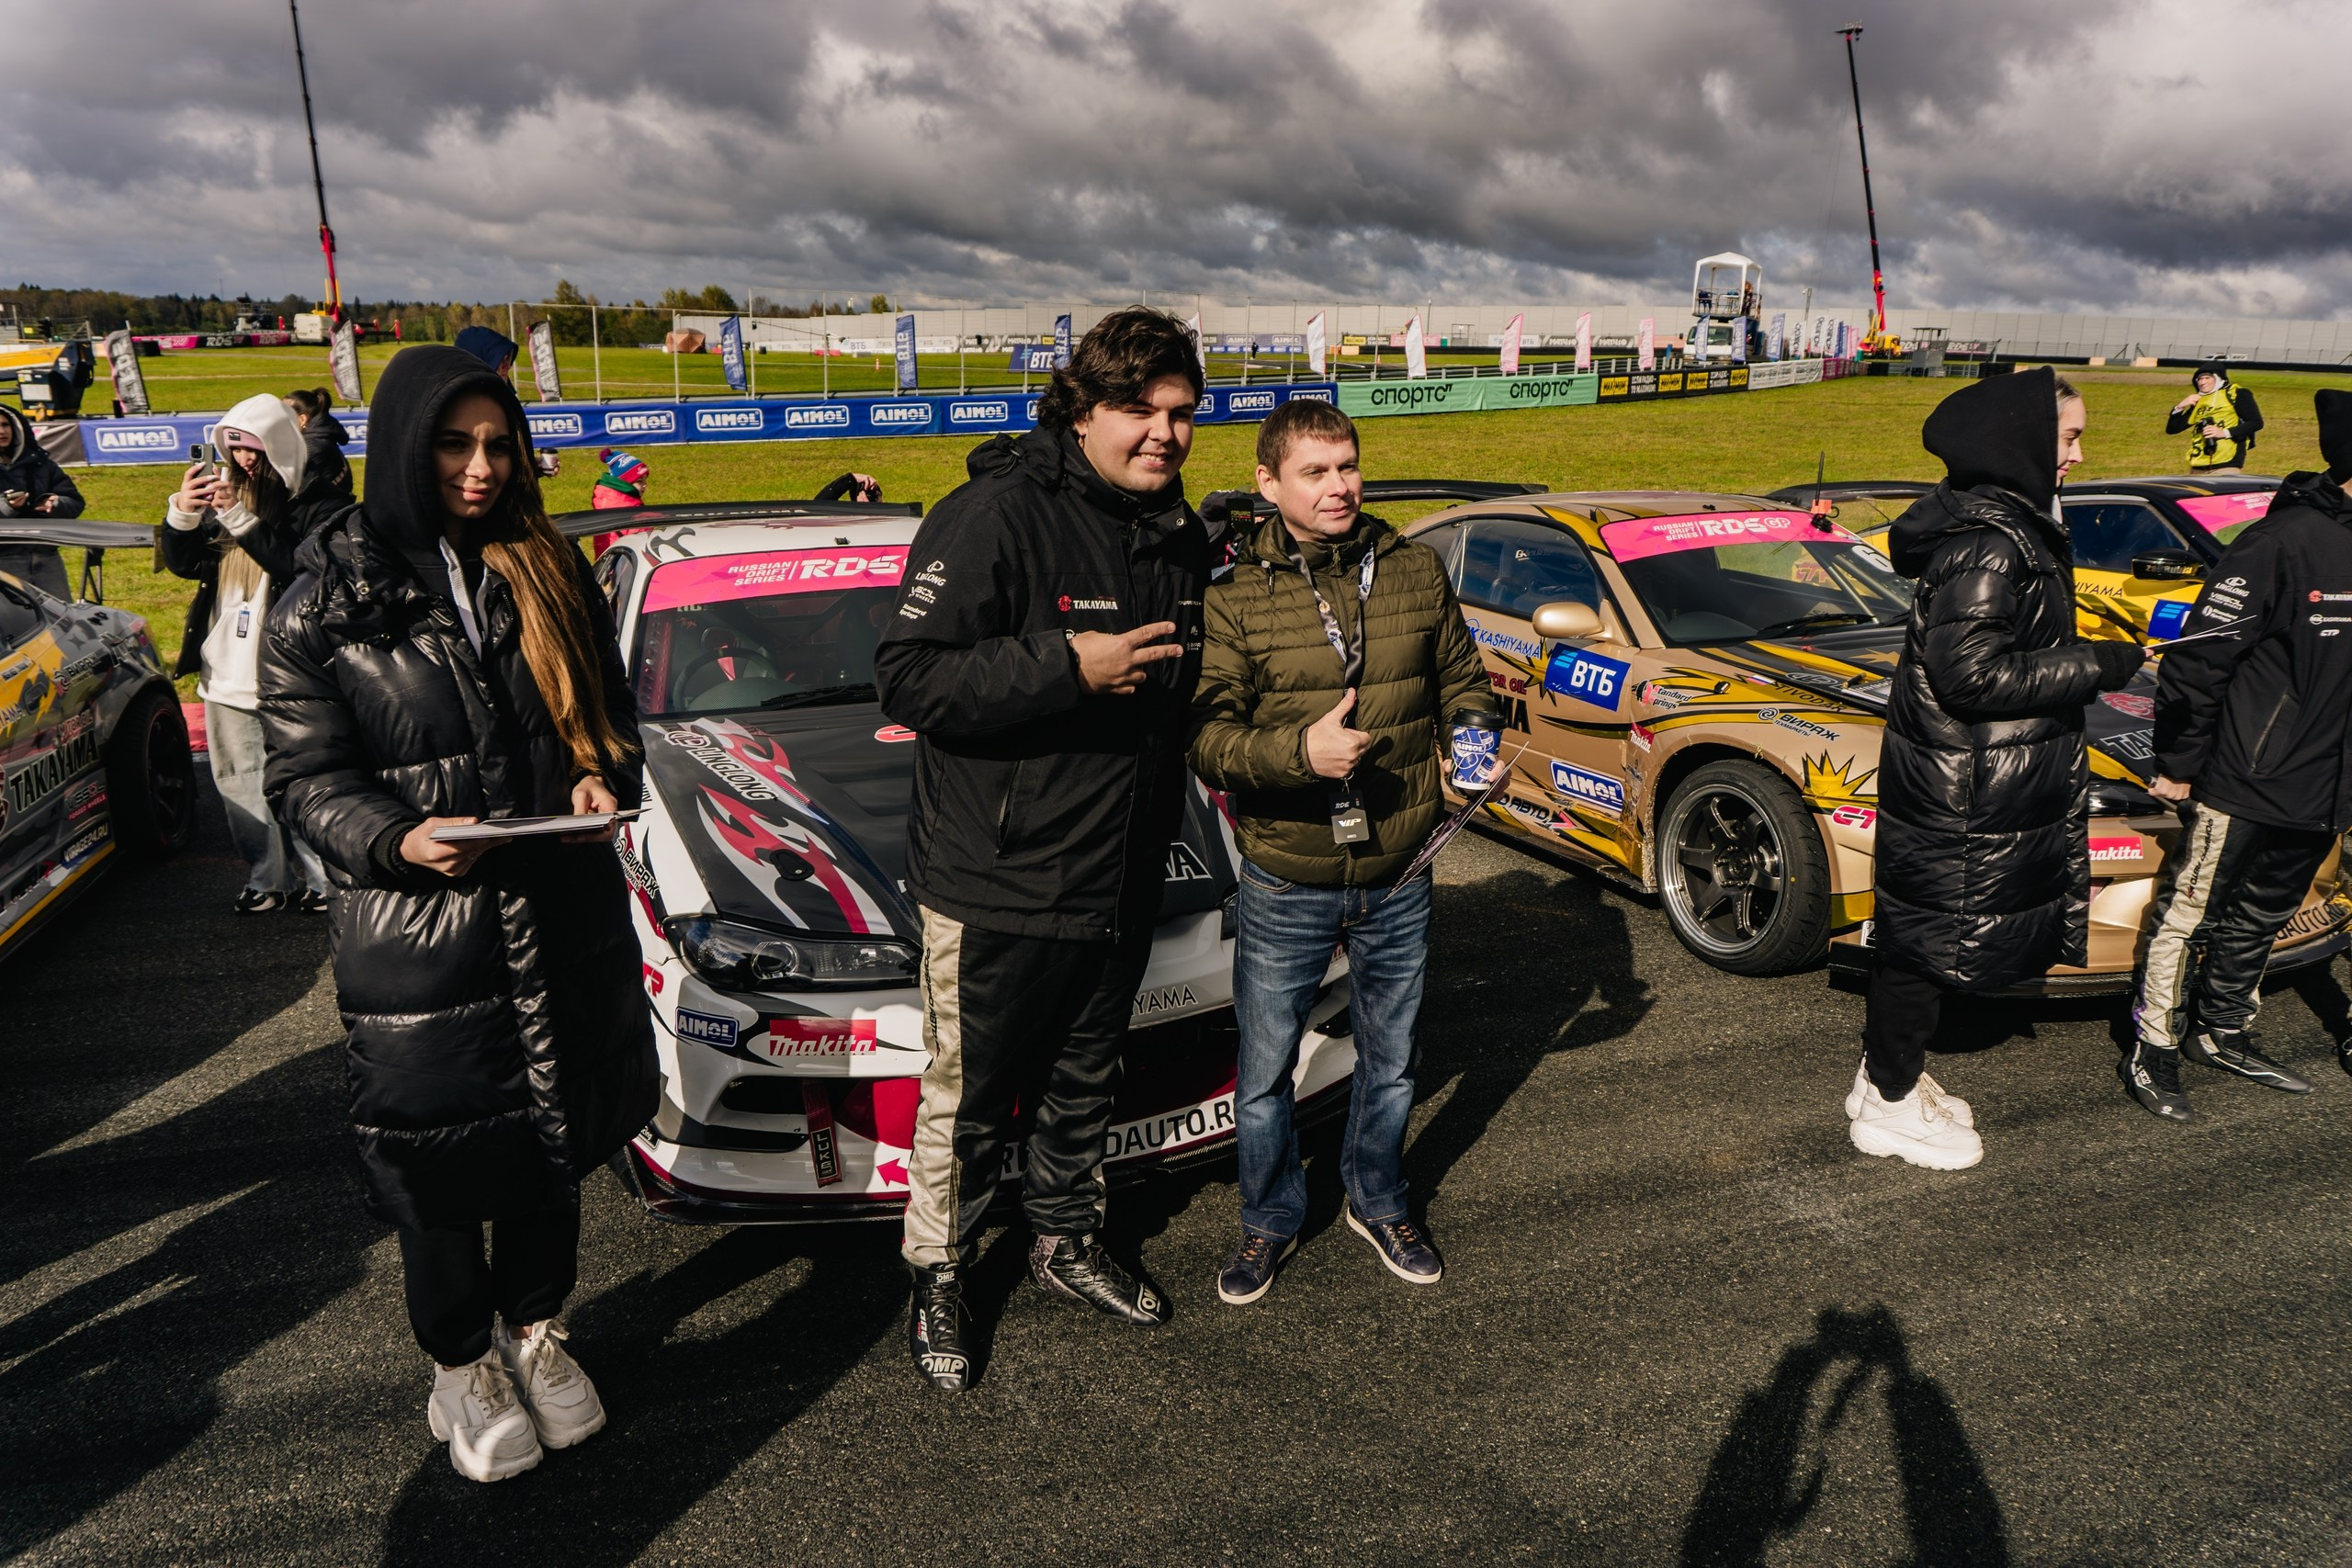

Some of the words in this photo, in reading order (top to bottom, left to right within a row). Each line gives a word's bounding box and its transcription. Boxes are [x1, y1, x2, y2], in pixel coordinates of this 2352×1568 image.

[1231, 394, 1273, 410] AIMOL
[700, 412, 760, 428] AIMOL
[789, 411, 846, 425] AIMOL
[874, 407, 929, 422] AIMOL
[953, 406, 1005, 419] AIMOL
[530, 419, 578, 434] IMOL
[609, 415, 672, 431] AIMOL
[101, 432, 173, 447] AIMOL
[1654, 521, 1694, 532] RUSSIAN
[1668, 526, 1696, 536] DRIFT
[1699, 517, 1769, 536] RDS
[1764, 516, 1792, 530] GP
[1665, 531, 1699, 541] SERIES
[728, 560, 792, 574] RUSSIAN
[745, 568, 789, 579] DRIFT
[799, 555, 902, 580] RDS
[734, 574, 786, 586] SERIES
[1477, 627, 1541, 660] KASHIYAMA
[1570, 660, 1618, 697] ВТБ
[1510, 680, 1528, 695] OIL
[1653, 684, 1692, 703] Standard
[1651, 695, 1679, 710] Springs
[1779, 712, 1841, 741] ВИРАЖ
[1456, 742, 1484, 752] AIMOL
[8, 731, 99, 814] TAKAYAMA
[686, 744, 778, 801] LINGLONG
[1555, 769, 1624, 802] AIMOL
[1338, 818, 1362, 827] VIP
[1832, 805, 1877, 829] CT
[677, 1014, 733, 1042] AIMOL
[1103, 1100, 1236, 1159] DAUTO.R
[936, 1273, 956, 1282] OMP
[922, 1357, 965, 1374] OMP
